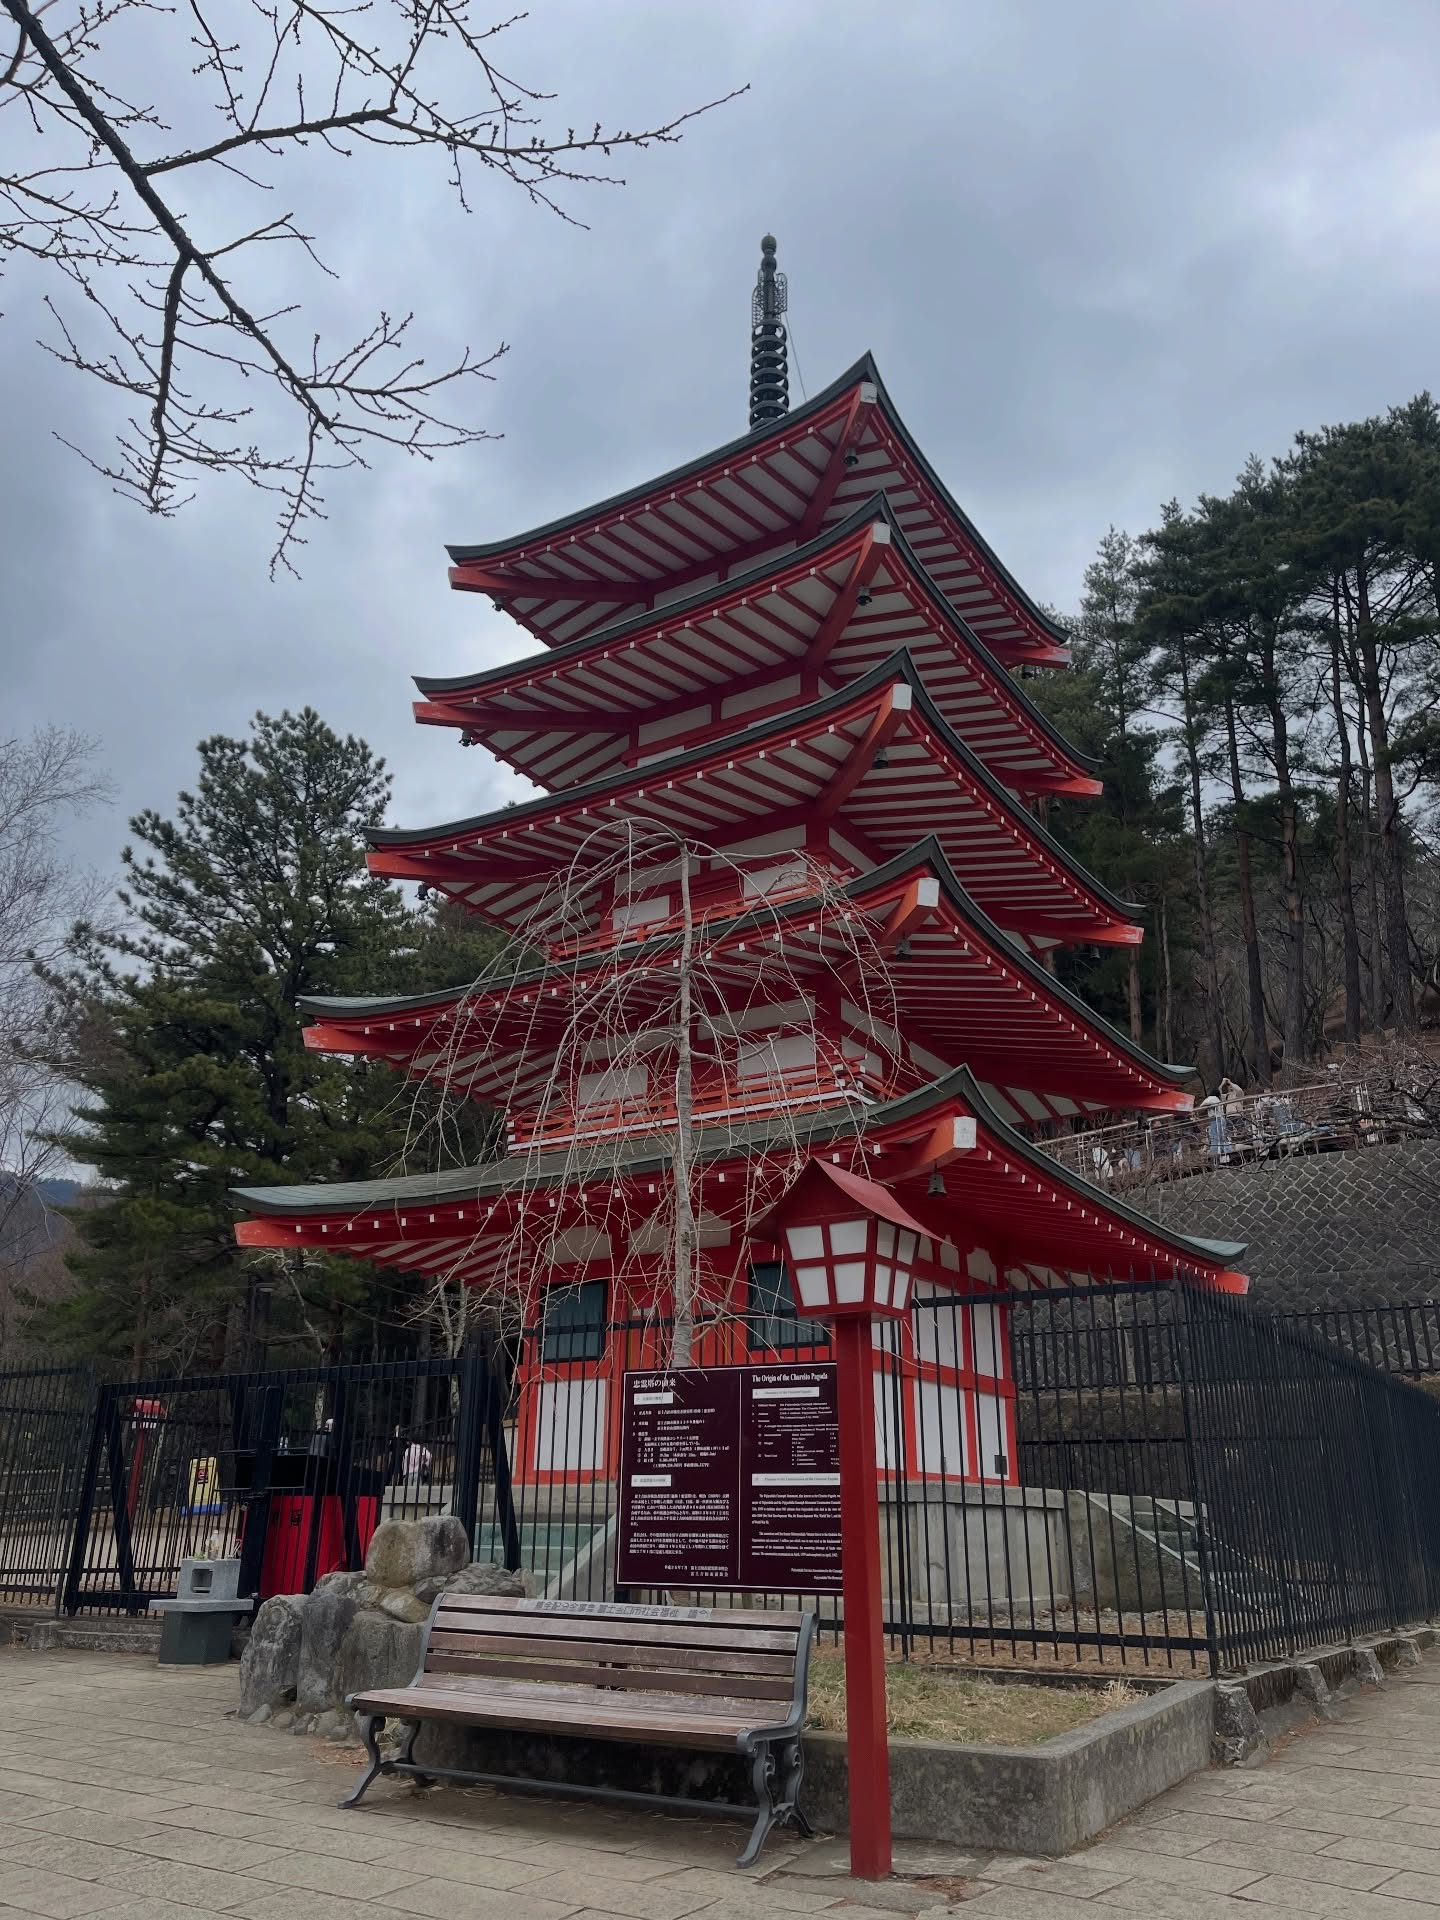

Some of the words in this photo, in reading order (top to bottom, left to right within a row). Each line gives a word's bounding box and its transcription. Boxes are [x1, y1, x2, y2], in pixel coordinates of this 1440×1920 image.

[762, 1375, 776, 1383] Origin
[777, 1373, 783, 1381] of
[811, 1373, 828, 1382] Pagoda
